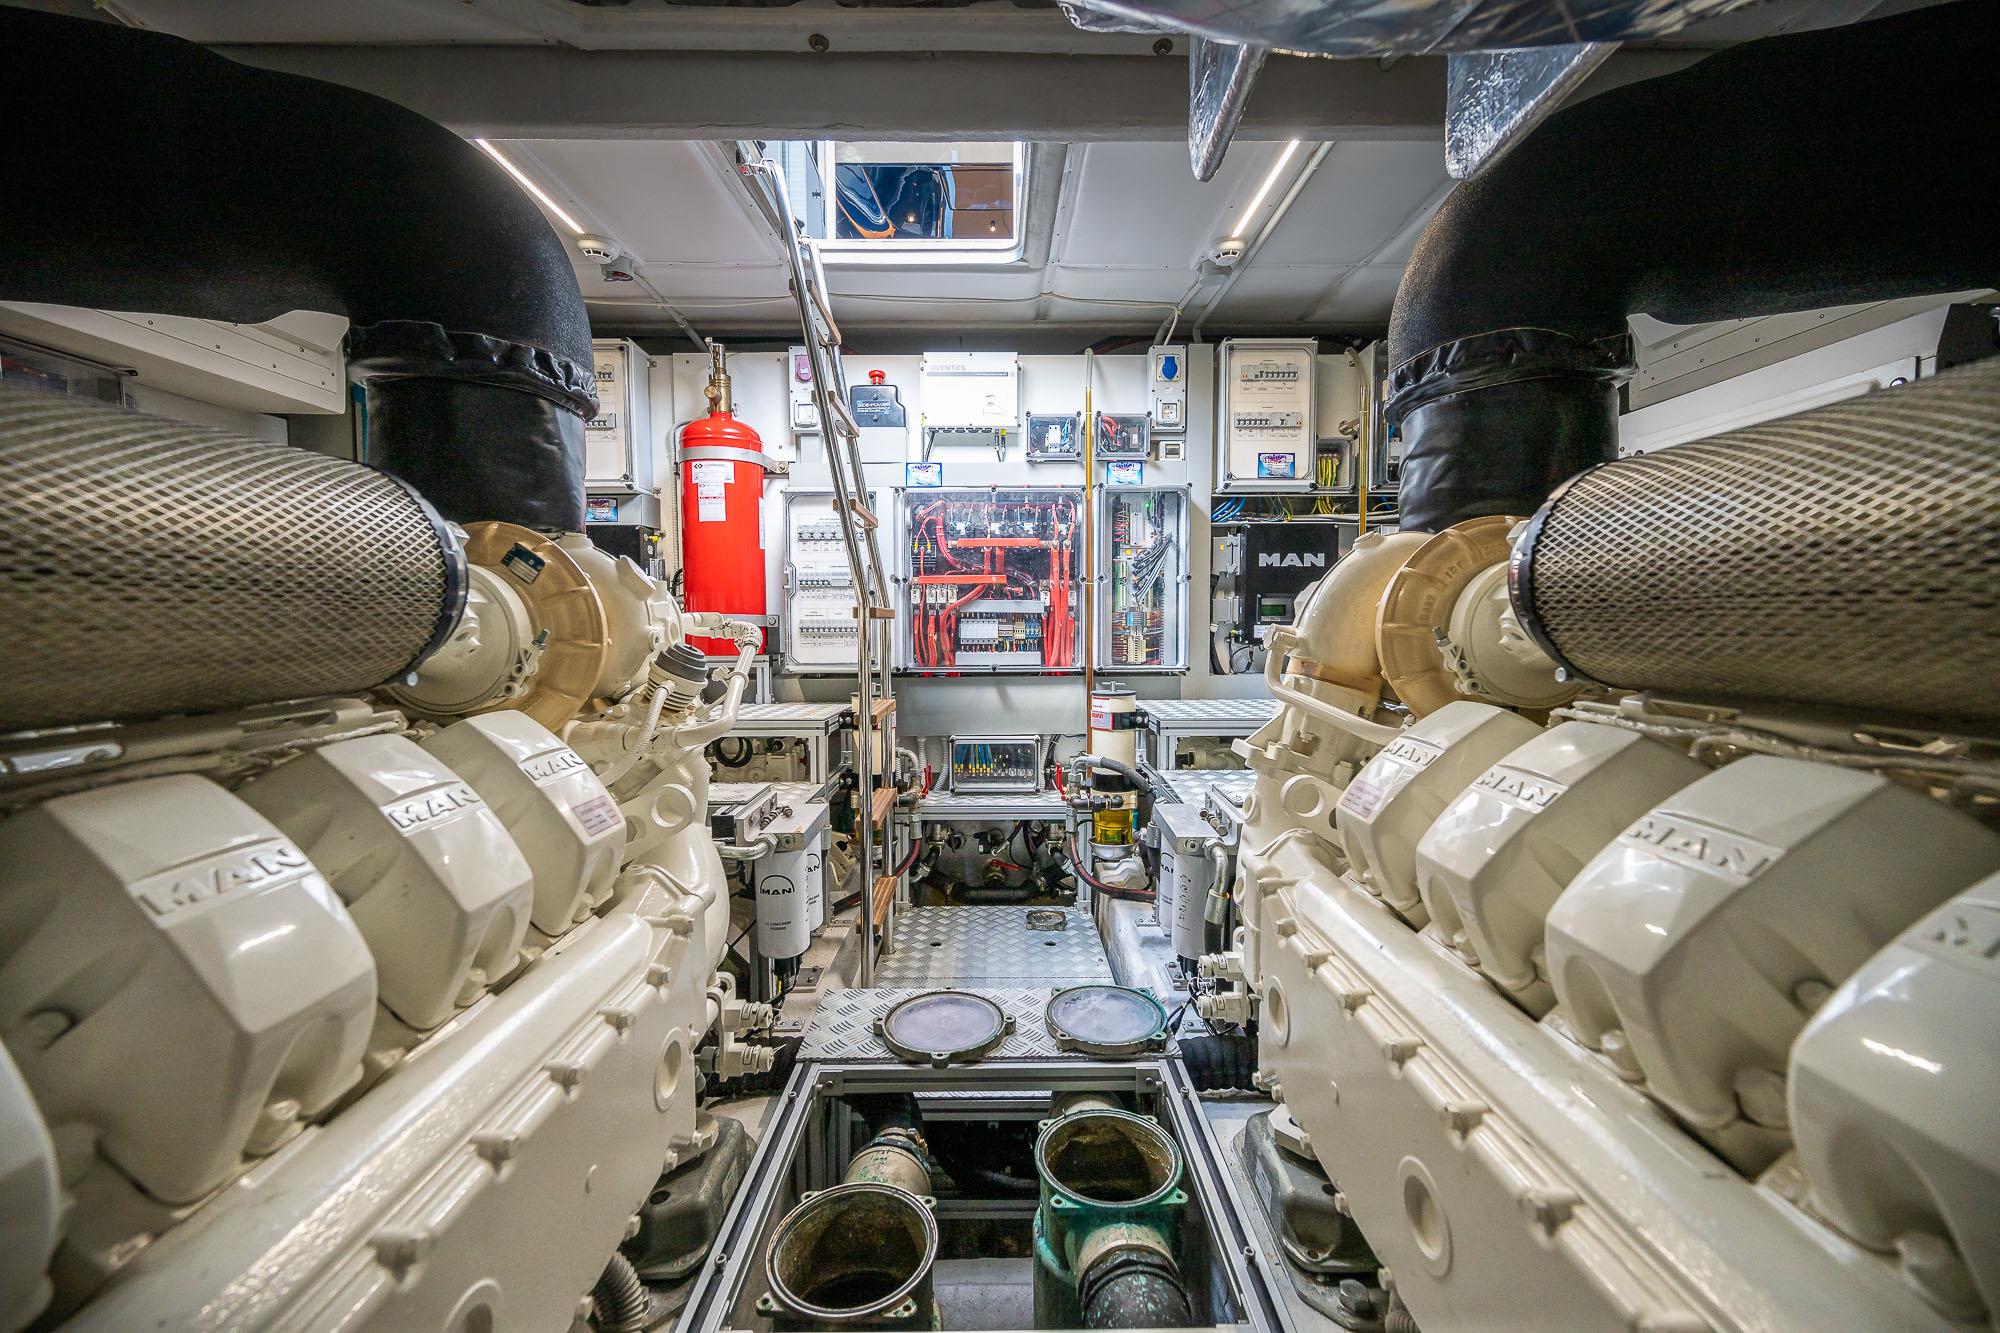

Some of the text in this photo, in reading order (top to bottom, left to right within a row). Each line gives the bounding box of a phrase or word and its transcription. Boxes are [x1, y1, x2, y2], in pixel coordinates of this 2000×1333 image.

[1259, 553, 1325, 567] MAN
[524, 752, 584, 781] MAN
[1475, 772, 1560, 807] MAN
[388, 787, 481, 829] MAN
[1628, 821, 1770, 878] MAN
[138, 847, 306, 915] MAN
[762, 887, 792, 895] MAN
